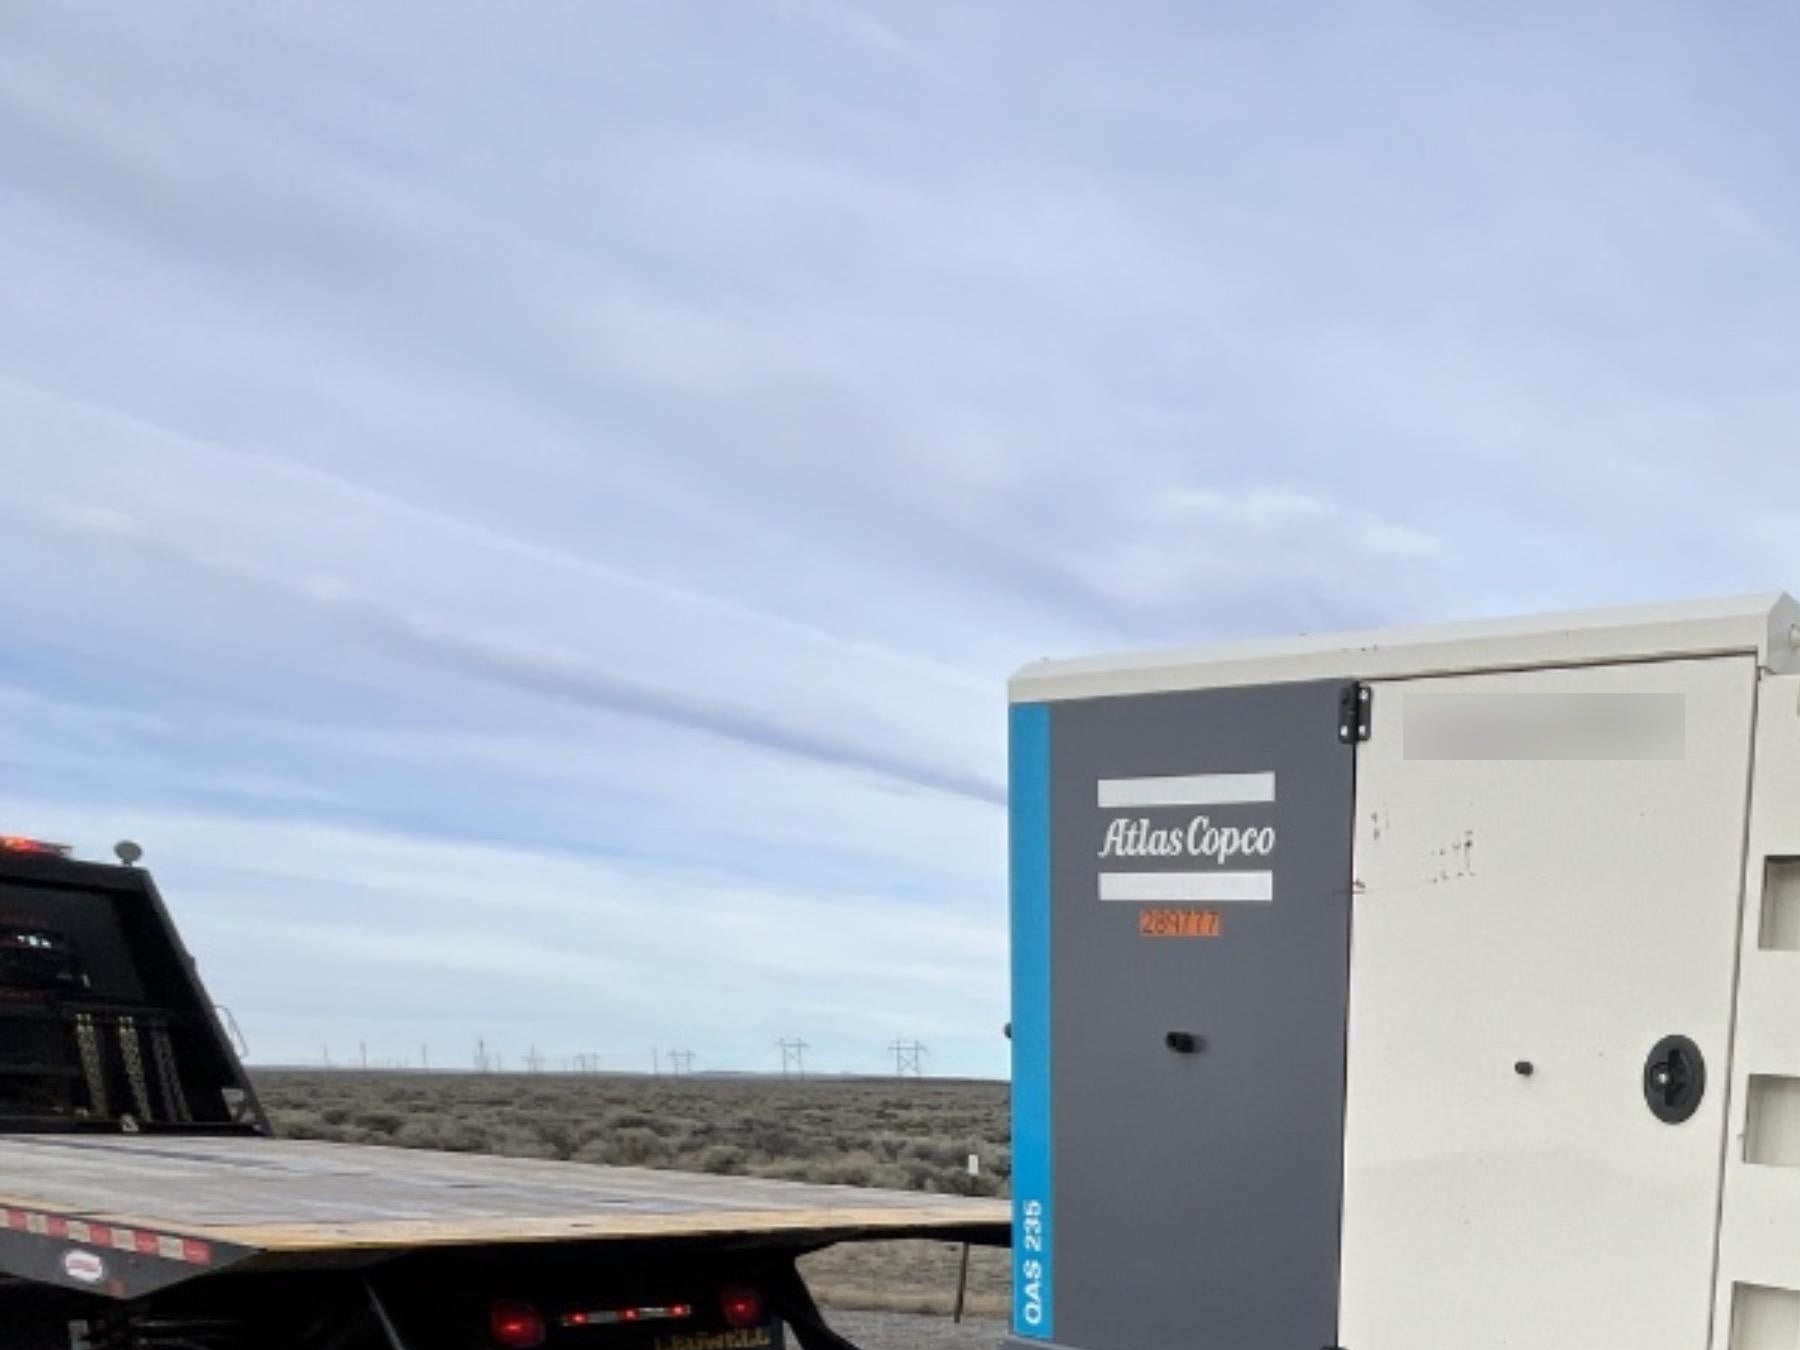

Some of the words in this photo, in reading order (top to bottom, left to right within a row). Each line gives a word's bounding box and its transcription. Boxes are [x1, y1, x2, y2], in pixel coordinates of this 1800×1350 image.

[1097, 818, 1183, 858] Atlas
[1187, 815, 1276, 864] Copco
[1023, 1199, 1042, 1252] 235
